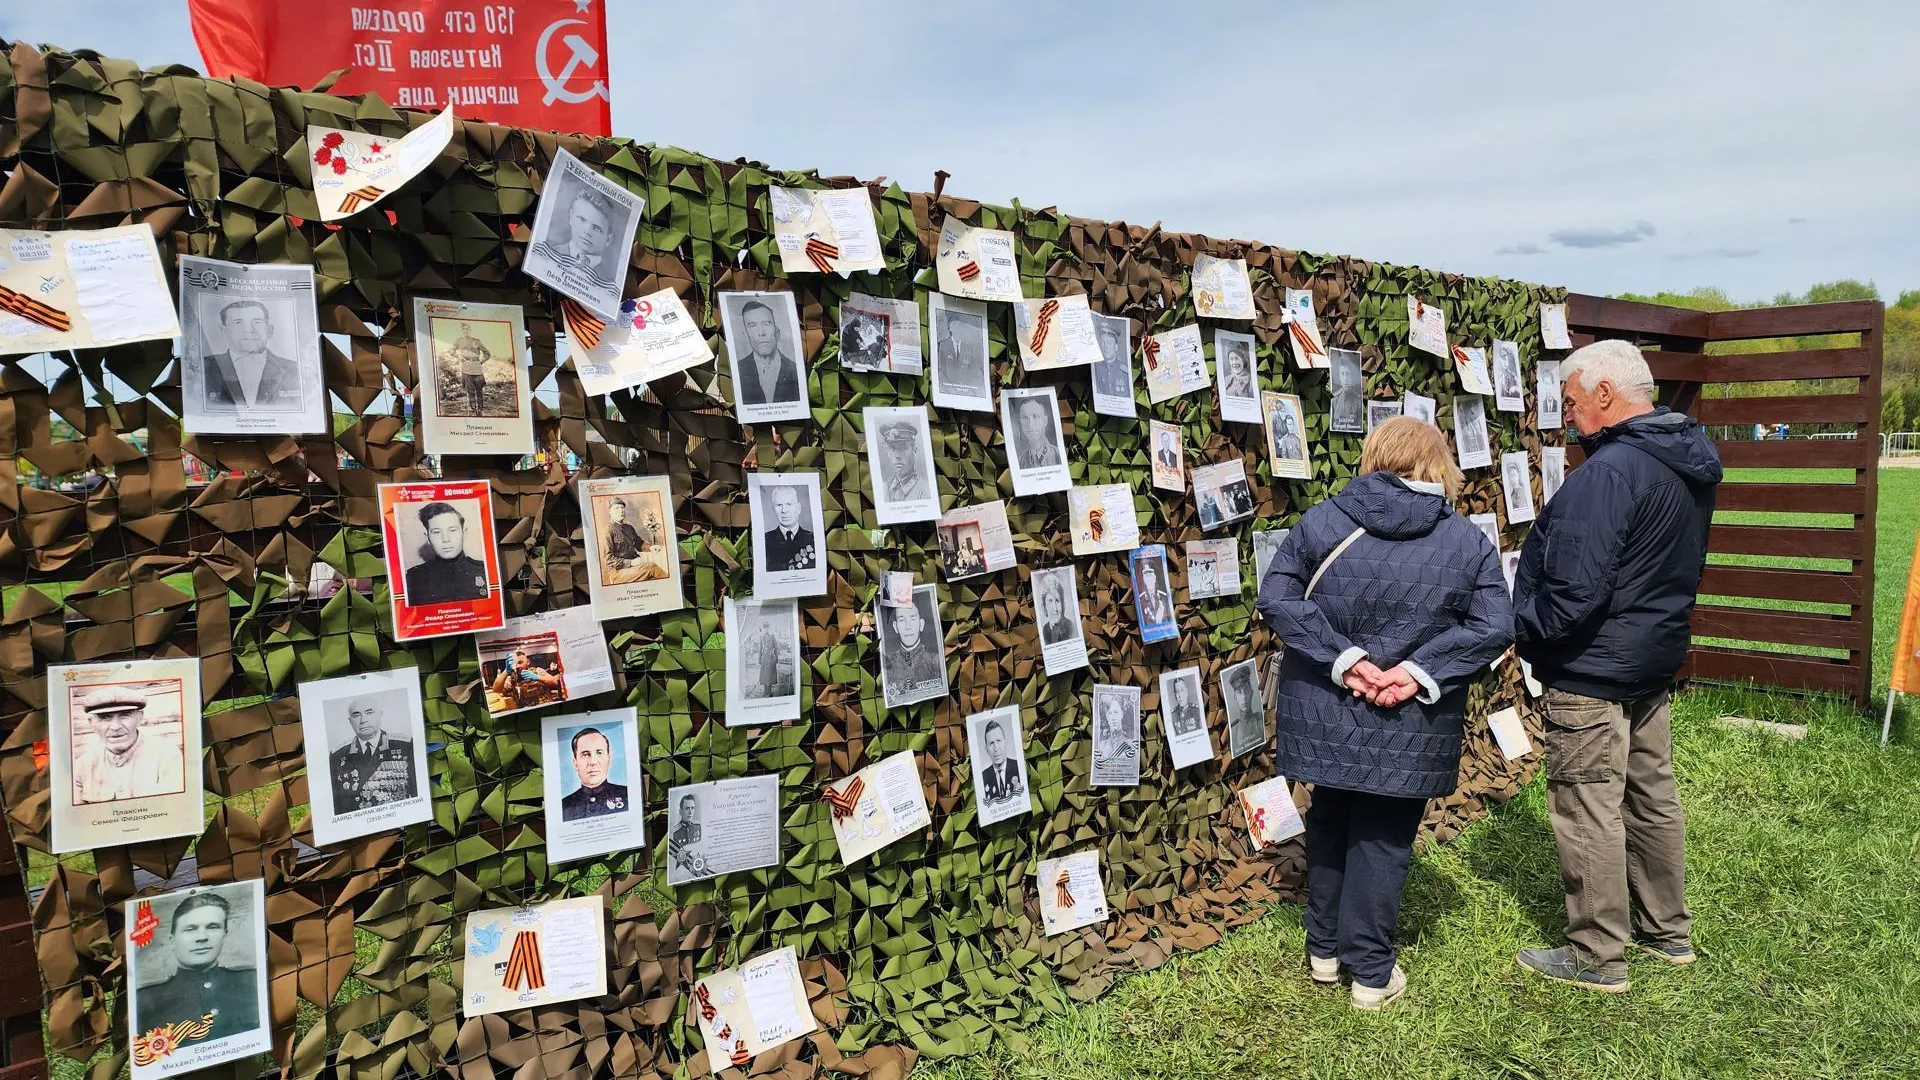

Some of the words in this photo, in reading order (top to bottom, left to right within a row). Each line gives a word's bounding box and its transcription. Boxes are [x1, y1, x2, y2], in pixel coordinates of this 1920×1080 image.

[573, 166, 617, 199] БЕССМЕРТНЫЙ
[617, 192, 633, 207] ПОЛК
[92, 817, 119, 826] Семен
[121, 811, 168, 823] Федорович
[112, 807, 148, 816] Плаксин
[331, 814, 353, 825] ДАВИД
[353, 805, 388, 818] АБРАМОВИЧ
[194, 1040, 230, 1055] Ефимов
[162, 1057, 195, 1072] Михаил
[196, 1041, 262, 1064] Александрович
